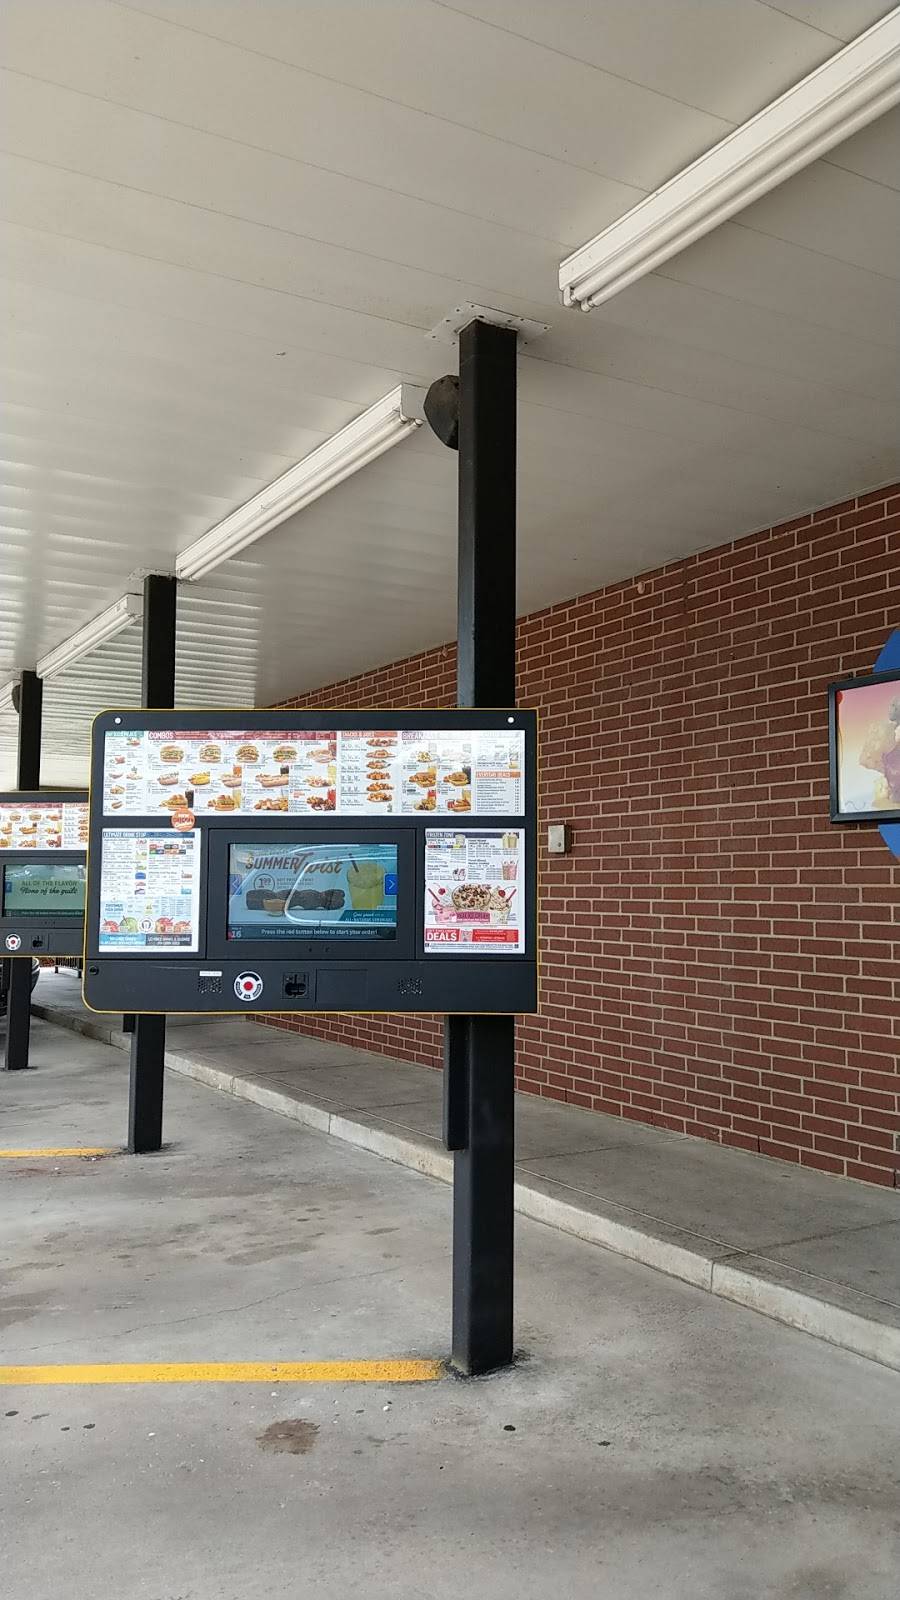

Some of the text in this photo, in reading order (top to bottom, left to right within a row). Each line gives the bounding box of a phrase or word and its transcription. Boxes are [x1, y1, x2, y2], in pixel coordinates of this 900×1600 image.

[149, 732, 175, 740] COMBOS
[245, 852, 343, 875] SUMMER Twist
[40, 886, 47, 896] of
[49, 886, 60, 894] the
[232, 930, 242, 938] 16
[427, 933, 457, 941] DEALS
